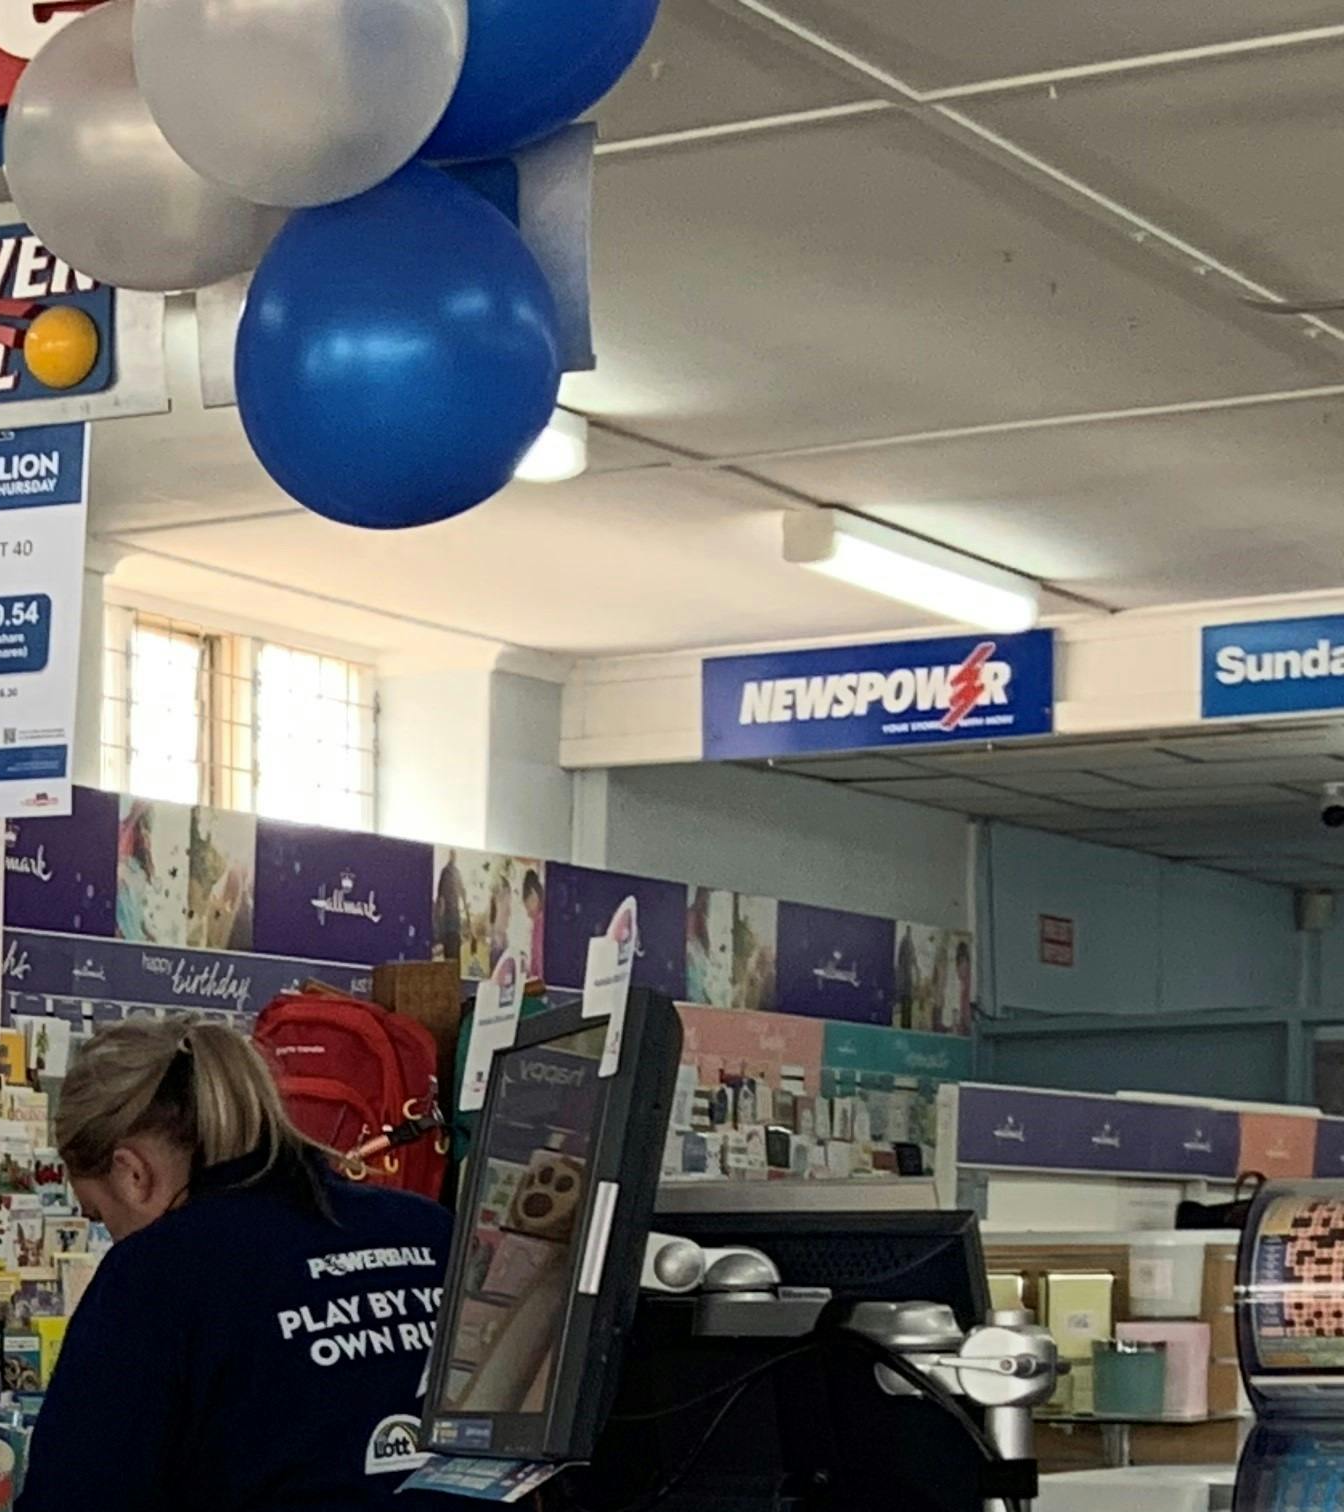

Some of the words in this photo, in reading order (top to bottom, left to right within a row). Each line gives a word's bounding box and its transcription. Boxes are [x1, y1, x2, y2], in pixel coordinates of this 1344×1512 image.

[13, 539, 34, 558] 40
[310, 882, 384, 926] Hallmark
[170, 956, 252, 1003] birthday
[306, 1246, 437, 1280] POWERBALL
[277, 1293, 362, 1341] PLAY
[368, 1288, 419, 1316] BY
[309, 1323, 394, 1368] OWN
[372, 1435, 411, 1462] Lott
